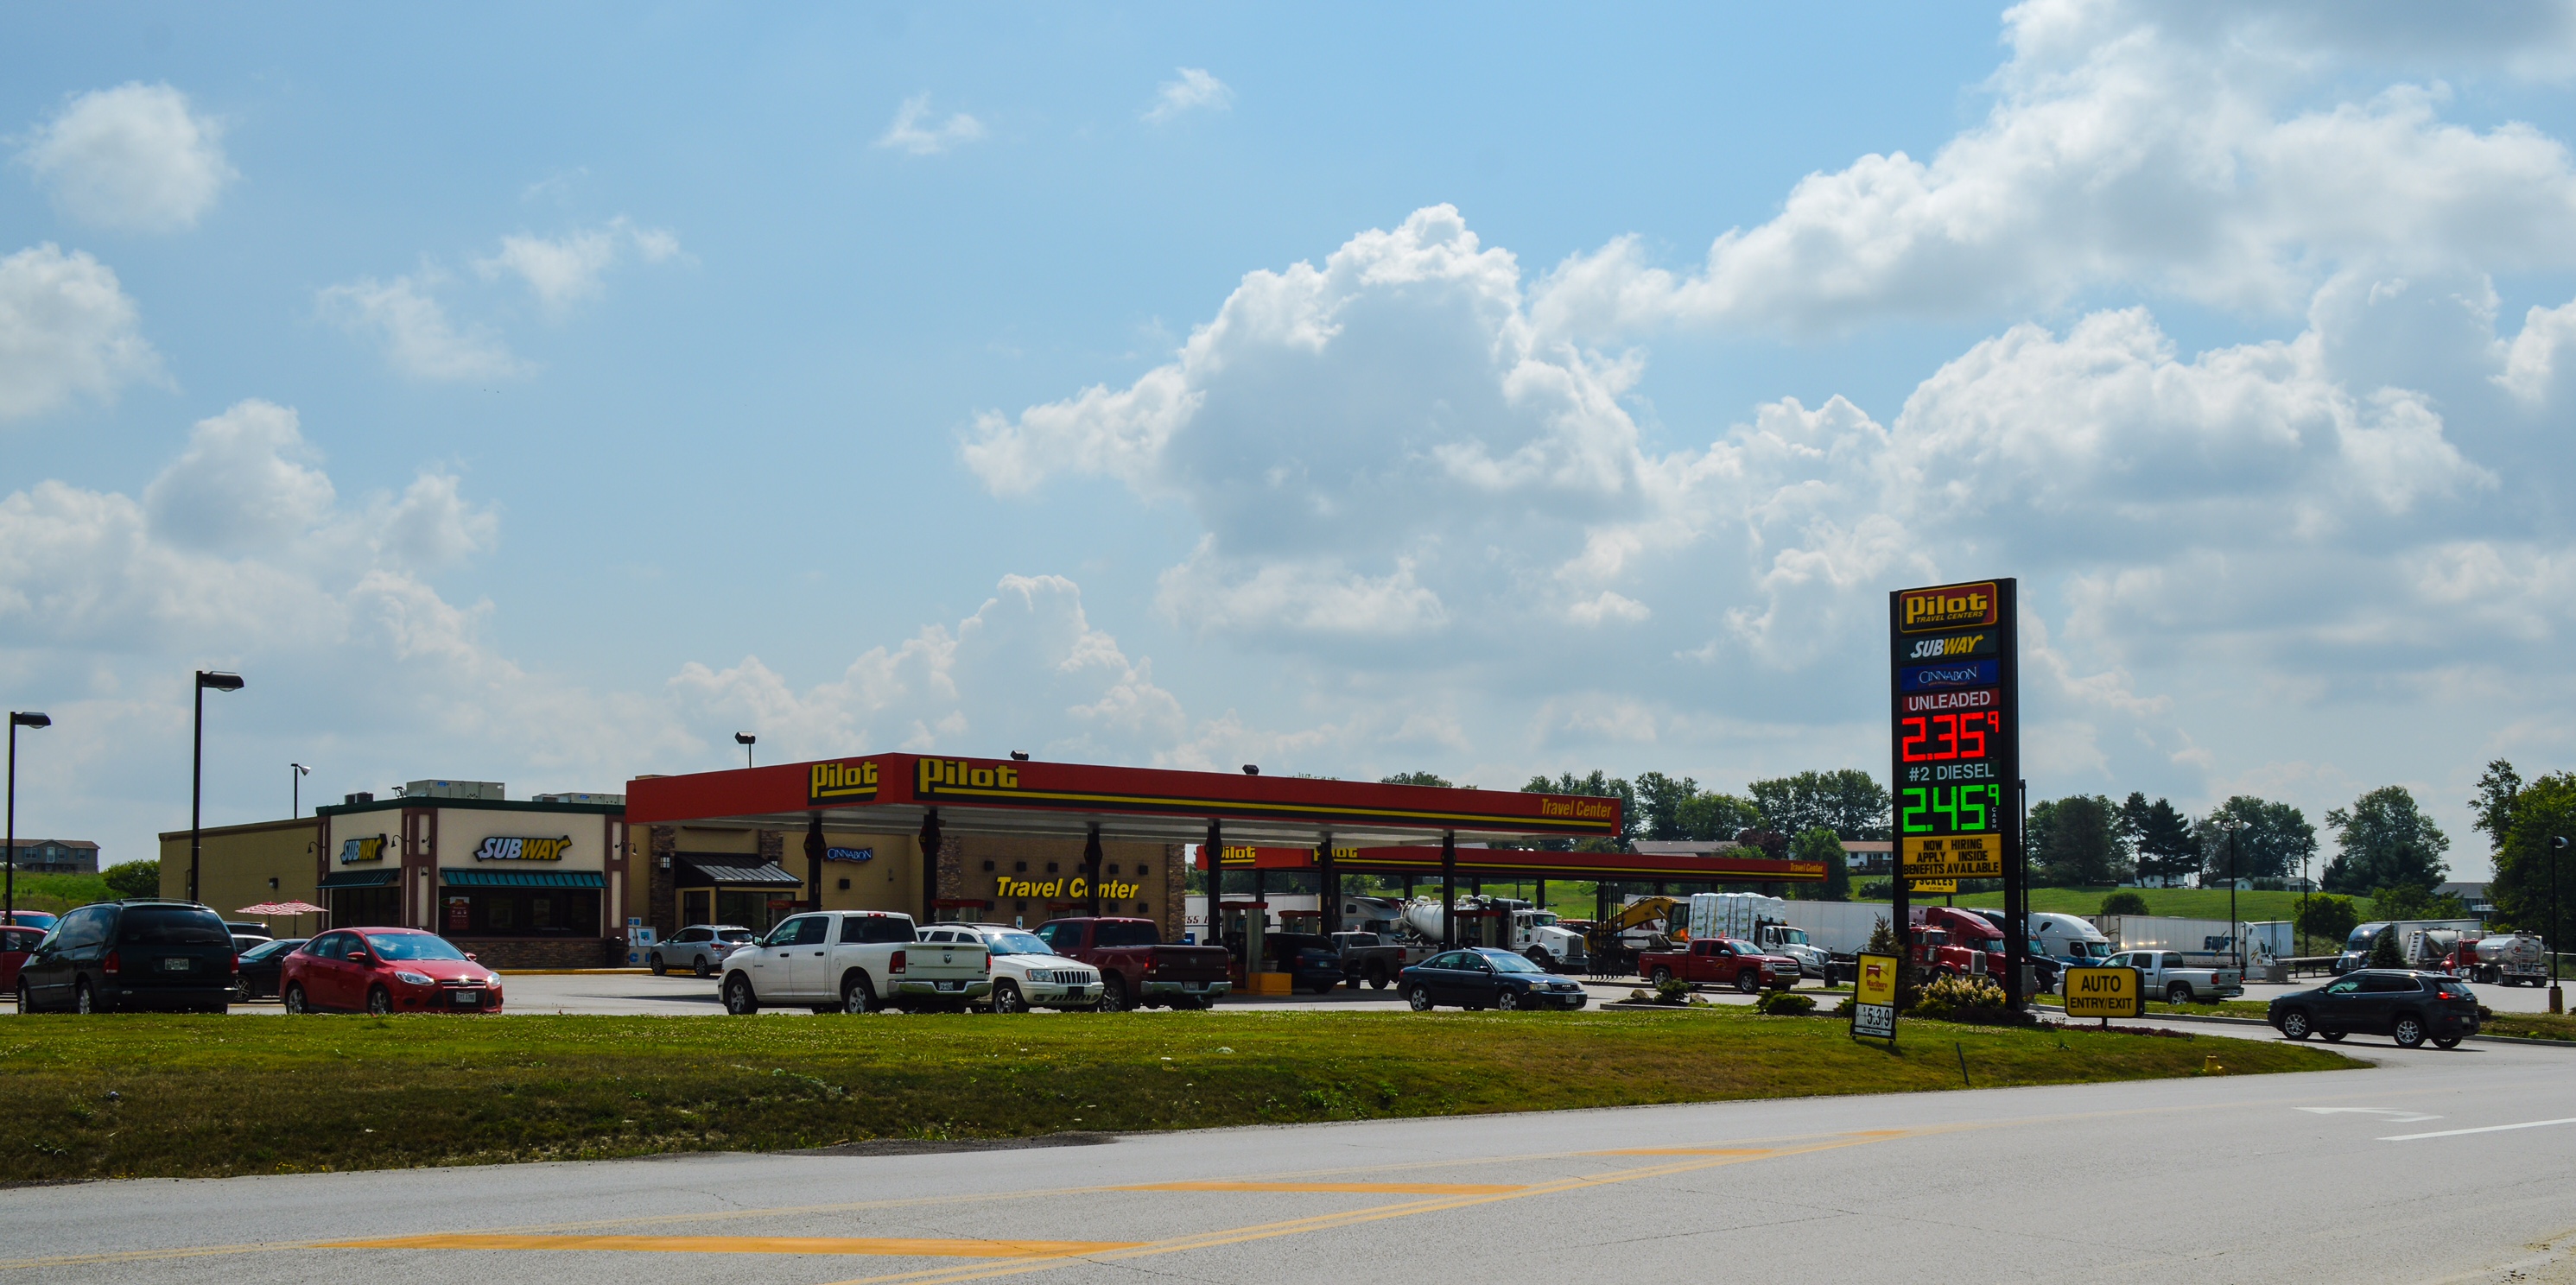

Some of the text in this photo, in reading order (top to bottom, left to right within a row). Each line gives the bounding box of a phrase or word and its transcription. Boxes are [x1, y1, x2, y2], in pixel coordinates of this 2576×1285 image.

[1907, 592, 1987, 624] Pilot
[1946, 611, 1984, 620] CENTERS
[1910, 634, 1983, 658] SUBWAY
[1919, 667, 1977, 683] CINNABON
[1908, 691, 1990, 711] UNLEADED
[811, 761, 878, 798] Pilot
[919, 757, 1018, 793] Pilot
[1909, 763, 1995, 782] #2 DIESEL
[1542, 798, 1612, 818] Travel Center
[340, 837, 382, 861] SUBWAY
[477, 836, 572, 860] SUBWAY
[1923, 839, 1983, 851] NOW HIRING
[827, 848, 872, 861] CINNABON
[1916, 851, 1988, 863] APPLY INSIDE
[1790, 863, 1823, 872] Travel Center
[1903, 862, 1999, 875] BENEFITS AVAILABLE
[996, 877, 1063, 897] Travel
[1867, 979, 1888, 989] Marlboro
[2081, 975, 2121, 992] AUTO
[2070, 997, 2132, 1010] ENTRY/EXIT
